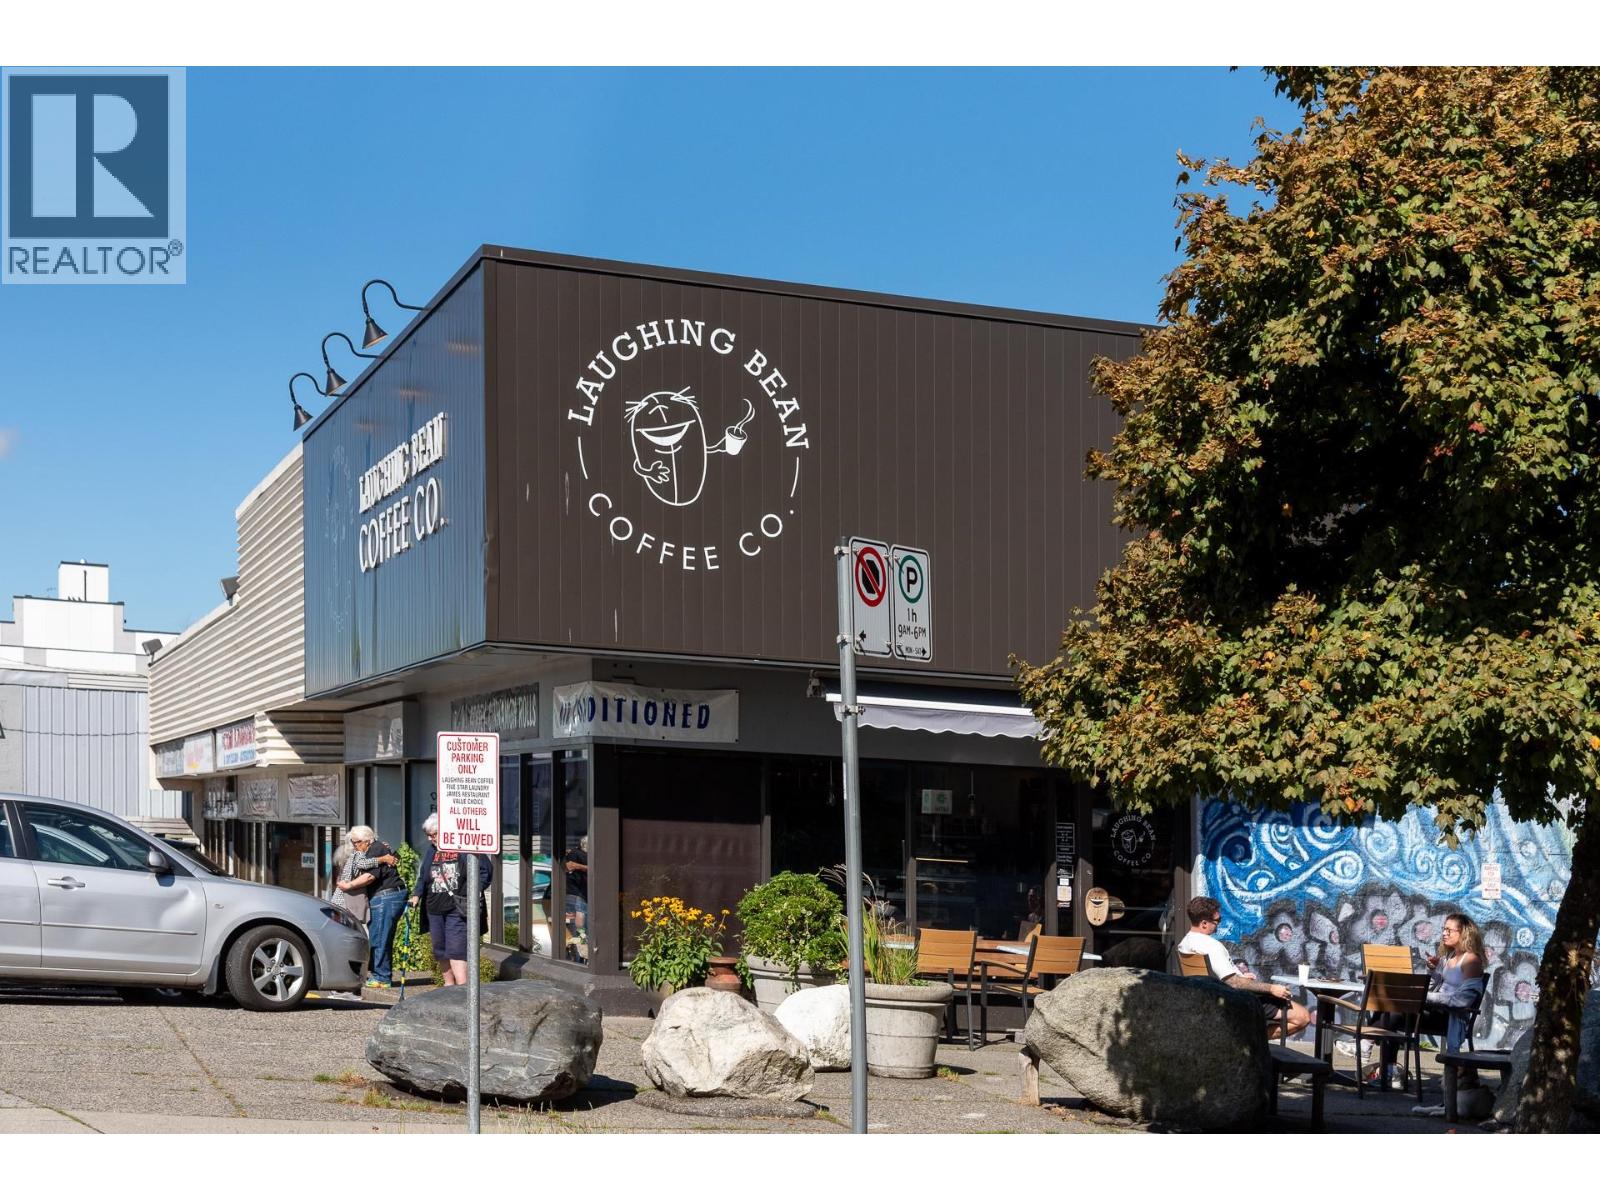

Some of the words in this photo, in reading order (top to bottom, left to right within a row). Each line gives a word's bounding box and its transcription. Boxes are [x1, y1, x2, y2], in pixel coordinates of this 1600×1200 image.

[567, 318, 736, 427] LAUGHING
[743, 349, 809, 449] BEAN
[359, 441, 410, 514] LAUGHING
[411, 412, 446, 478] BEAN
[359, 495, 410, 574] COFFEE
[413, 477, 449, 541] CO.
[588, 492, 720, 571] COFFEE
[738, 509, 795, 557] CO.
[906, 566, 919, 594] P
[518, 692, 536, 729] ROLLS
[446, 741, 489, 752] CUSTOMER
[451, 753, 484, 763] PARKING
[457, 764, 477, 774] ONLY
[449, 807, 461, 815] ALL
[462, 807, 487, 816] OTHERS
[456, 818, 480, 831] WILL
[443, 832, 455, 844] BE
[458, 833, 494, 846] TOWED
